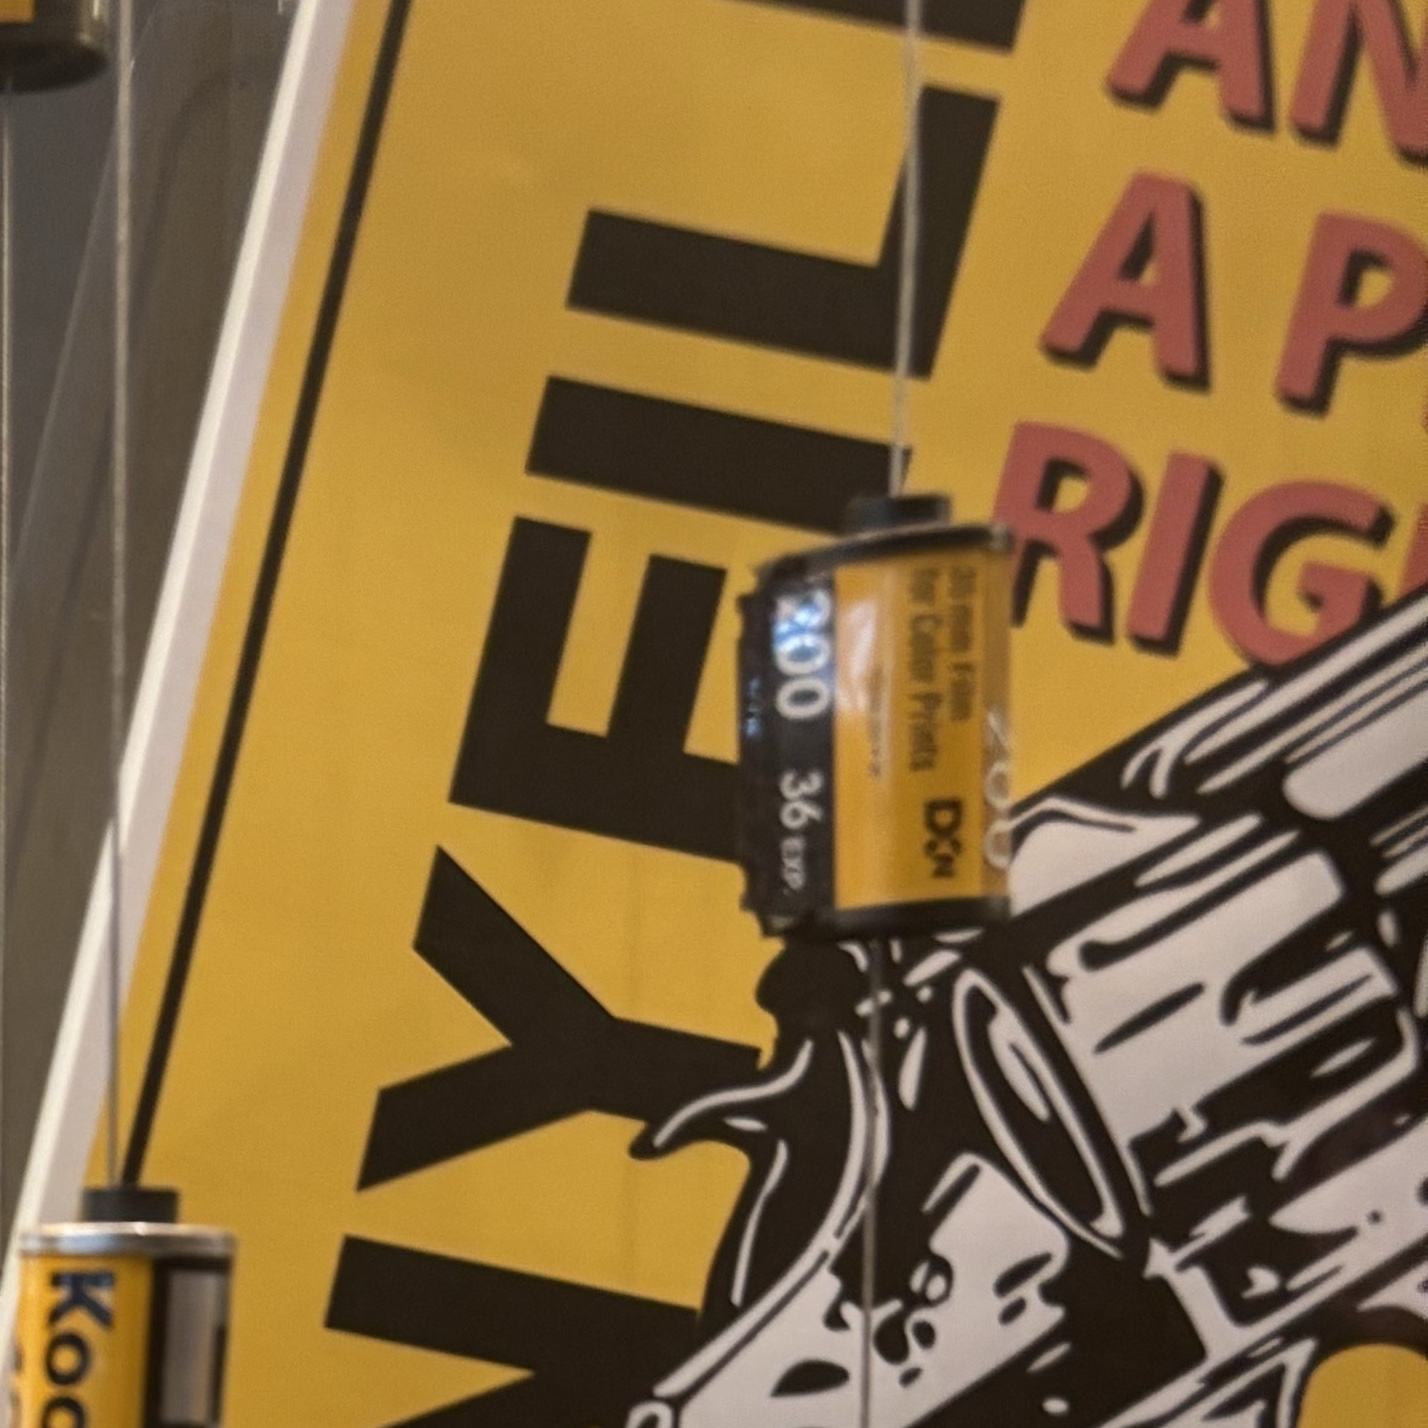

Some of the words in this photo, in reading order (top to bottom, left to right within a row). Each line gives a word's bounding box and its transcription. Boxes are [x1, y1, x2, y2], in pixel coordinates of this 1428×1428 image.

[1041, 168, 1210, 393] A
[994, 418, 1428, 668] RIG
[779, 770, 825, 832] 36
